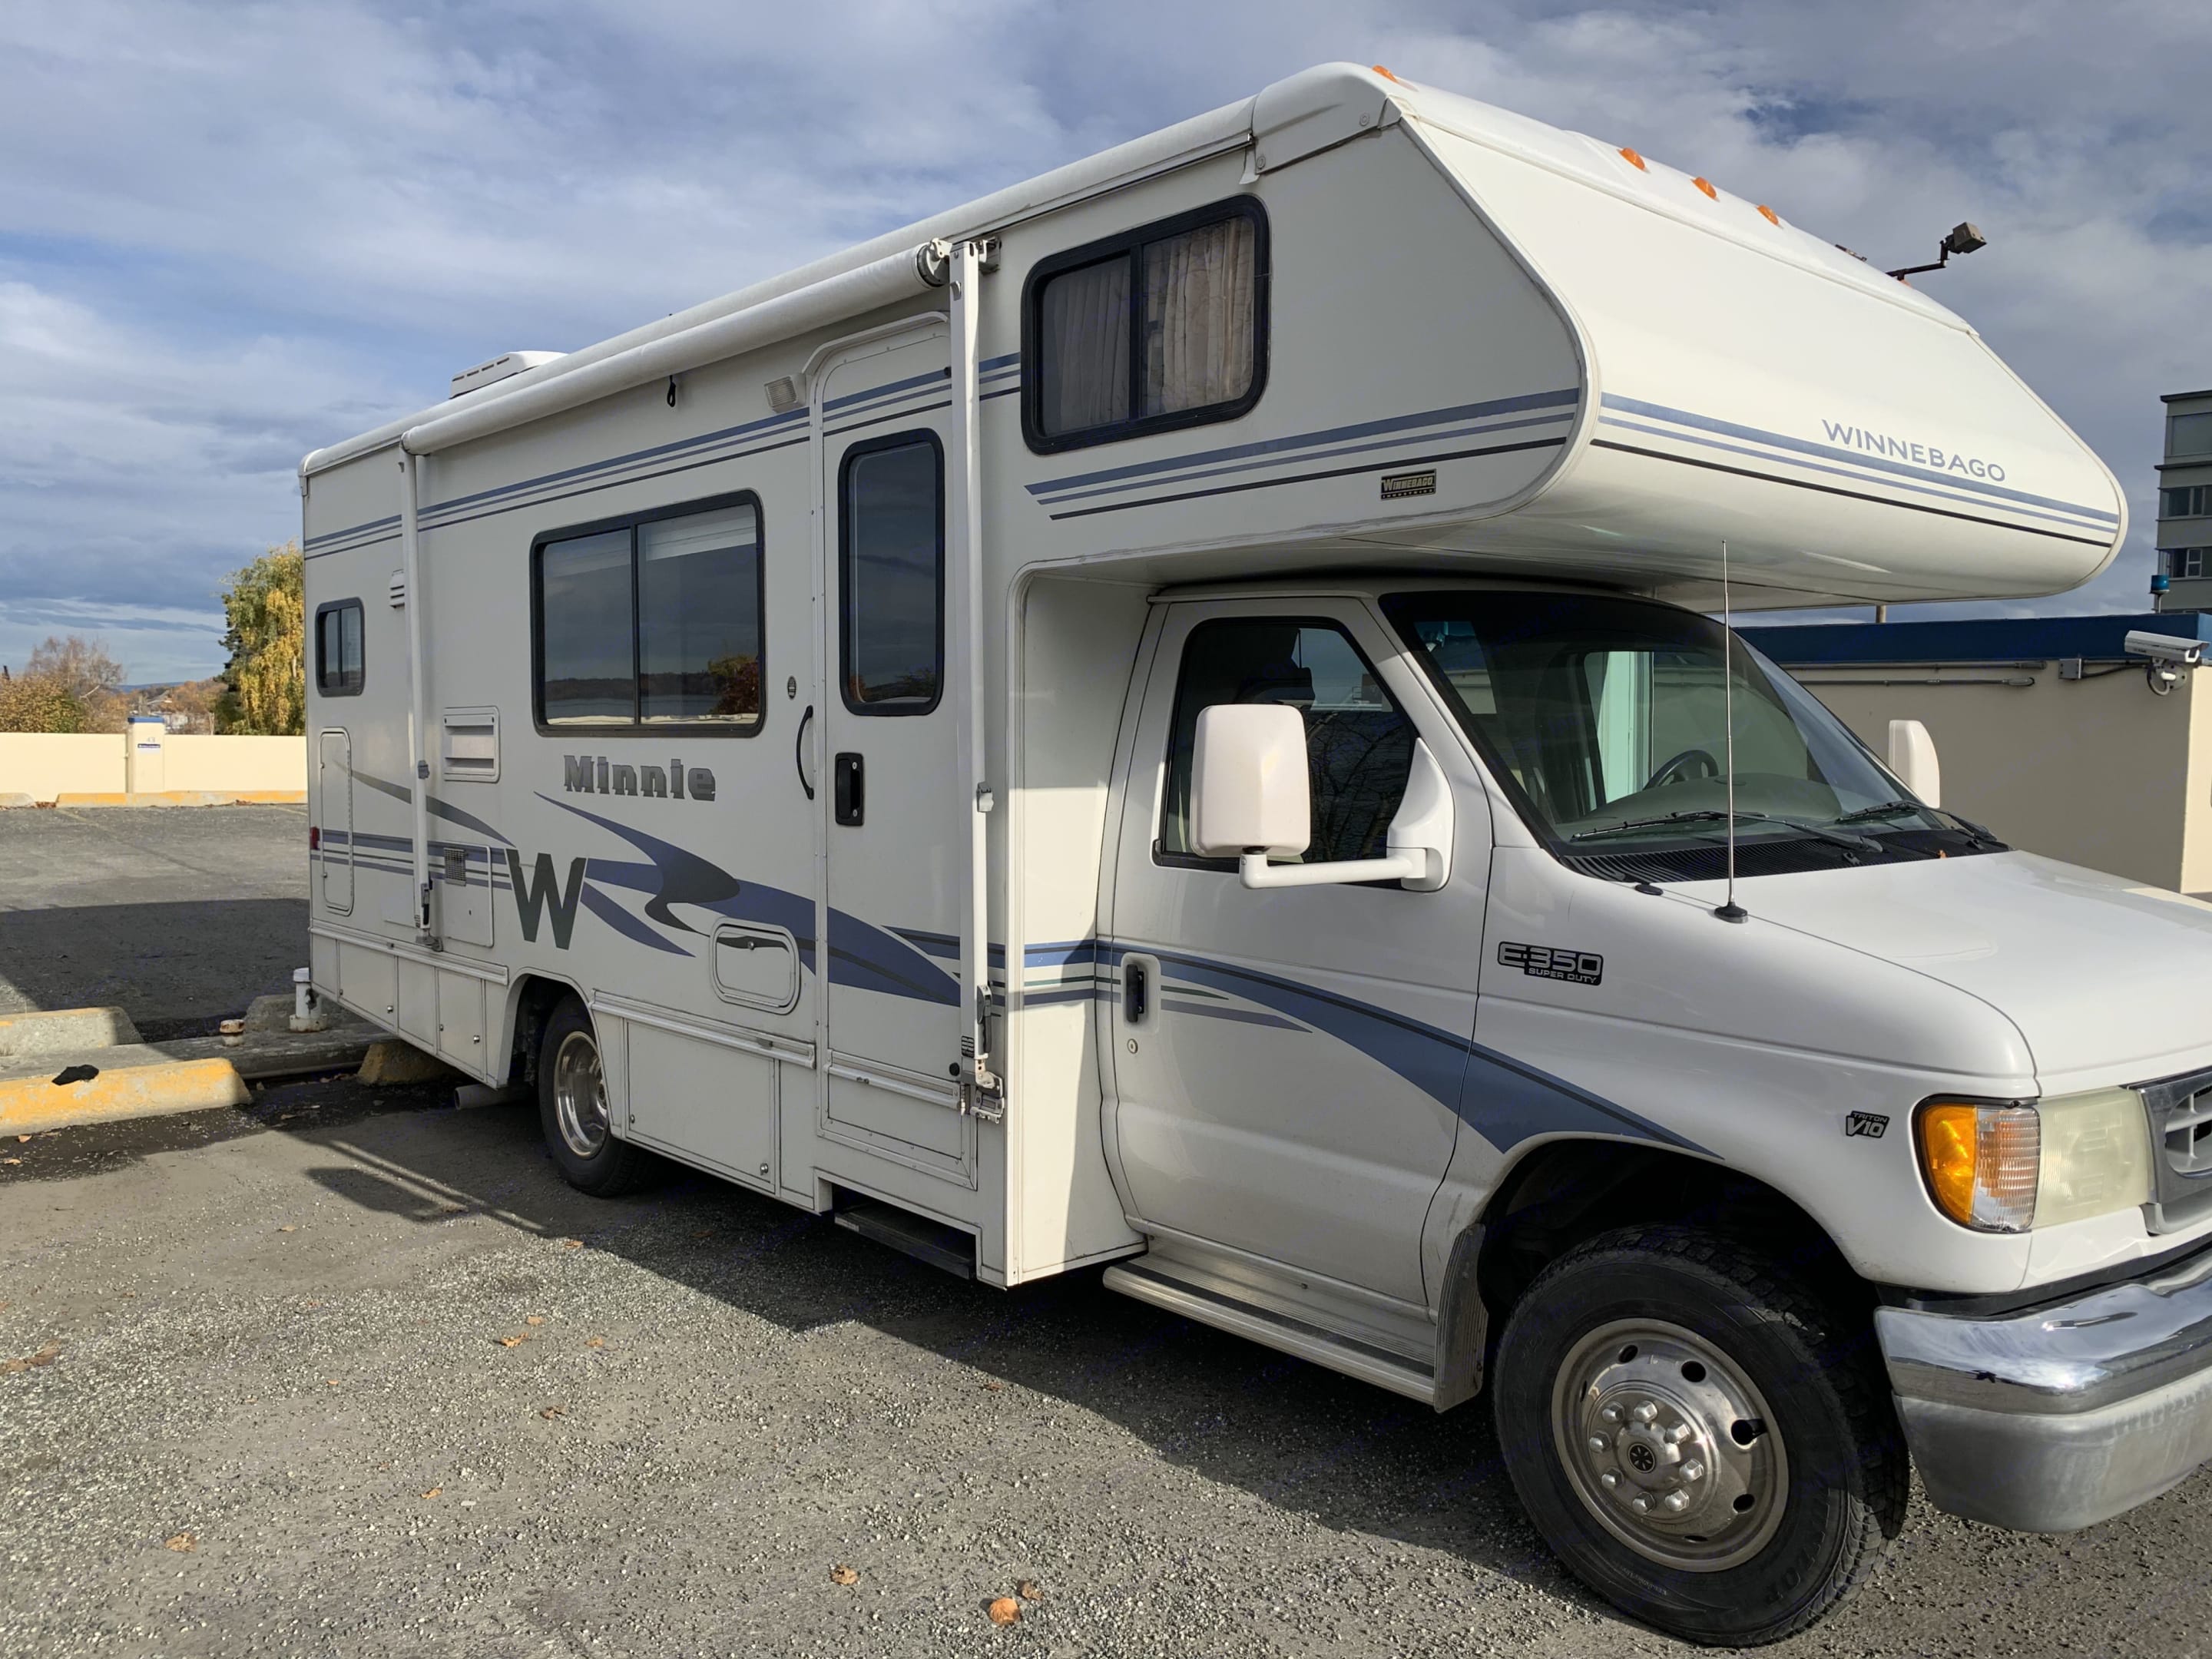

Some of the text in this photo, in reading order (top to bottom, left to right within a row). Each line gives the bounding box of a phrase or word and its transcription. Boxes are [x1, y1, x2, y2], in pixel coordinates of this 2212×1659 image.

[1821, 419, 2005, 482] WINNEBAGO
[564, 755, 716, 801] Minnie
[506, 848, 587, 950] W
[1528, 968, 1597, 984] SUPER DUTY
[1847, 1117, 1885, 1137] V10
[1853, 1112, 1888, 1123] TRITON
